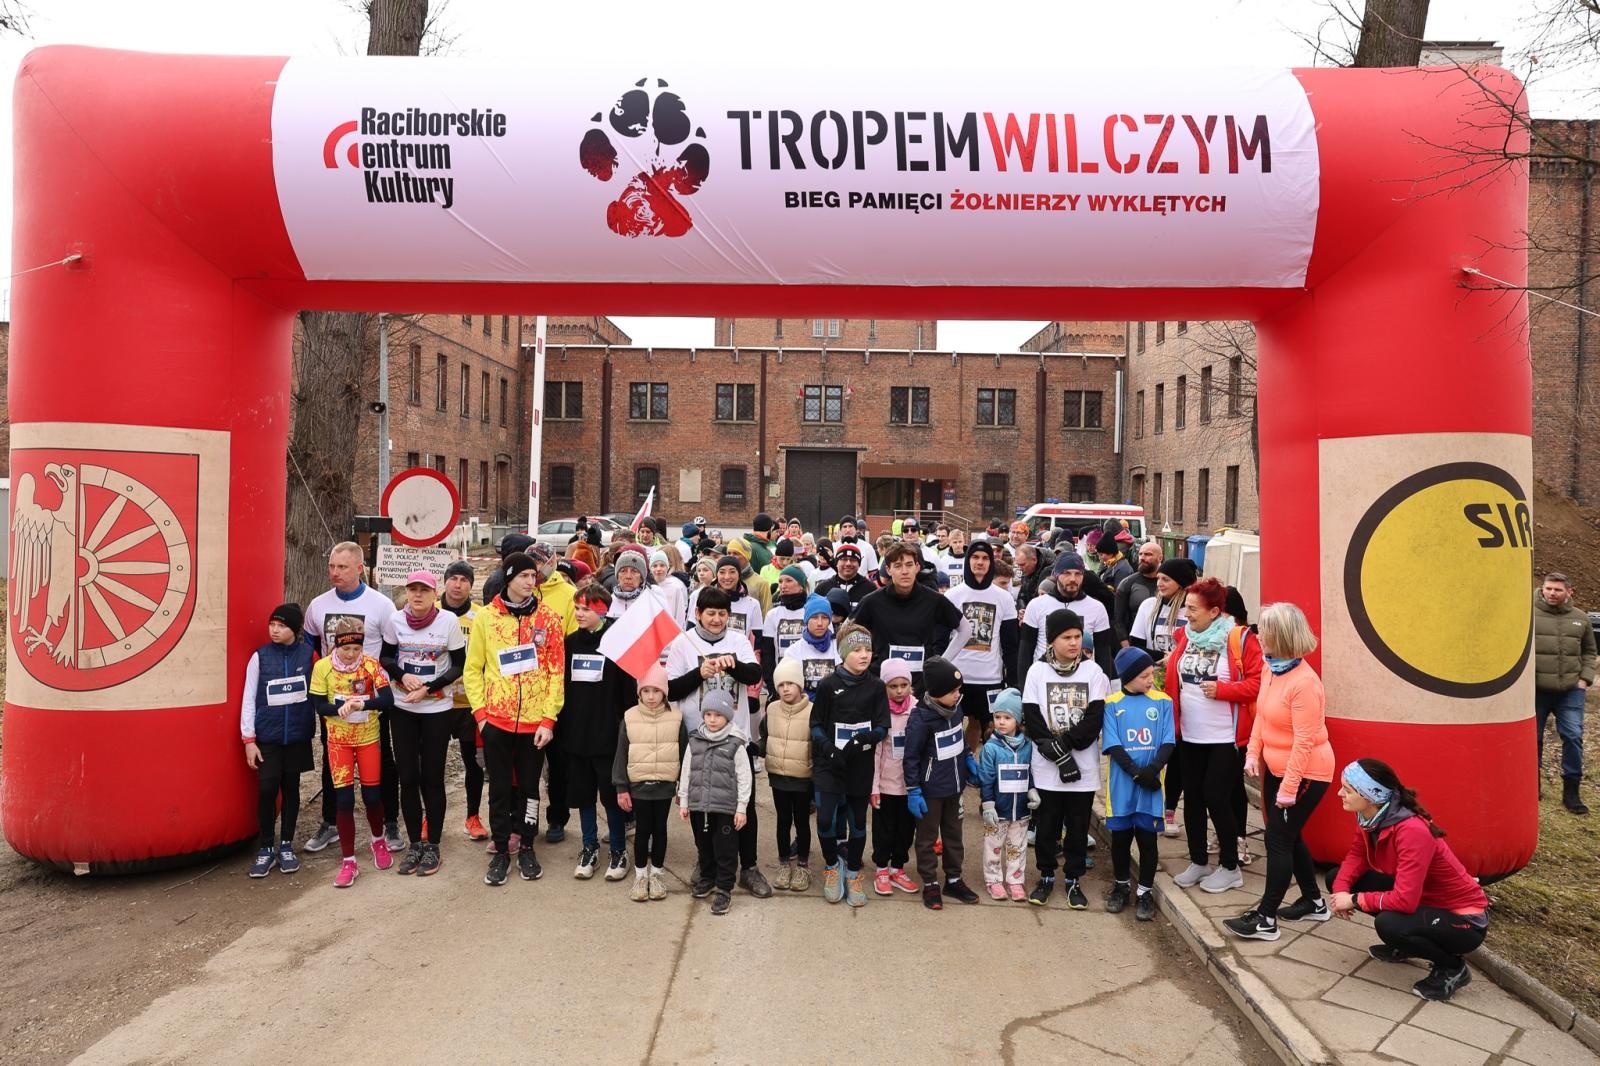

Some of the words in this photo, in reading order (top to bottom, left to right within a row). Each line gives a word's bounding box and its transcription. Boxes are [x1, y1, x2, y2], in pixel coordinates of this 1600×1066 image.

[360, 107, 506, 137] Raciborskie
[364, 170, 454, 209] Kultury
[784, 190, 841, 209] BIEG
[848, 191, 942, 215] PAMIĘCI
[949, 188, 1081, 212] ŻOŁNIERZY
[1087, 193, 1227, 216] WYKLĘTYCH
[513, 652, 522, 660] 32
[524, 797, 540, 826] NIKE
